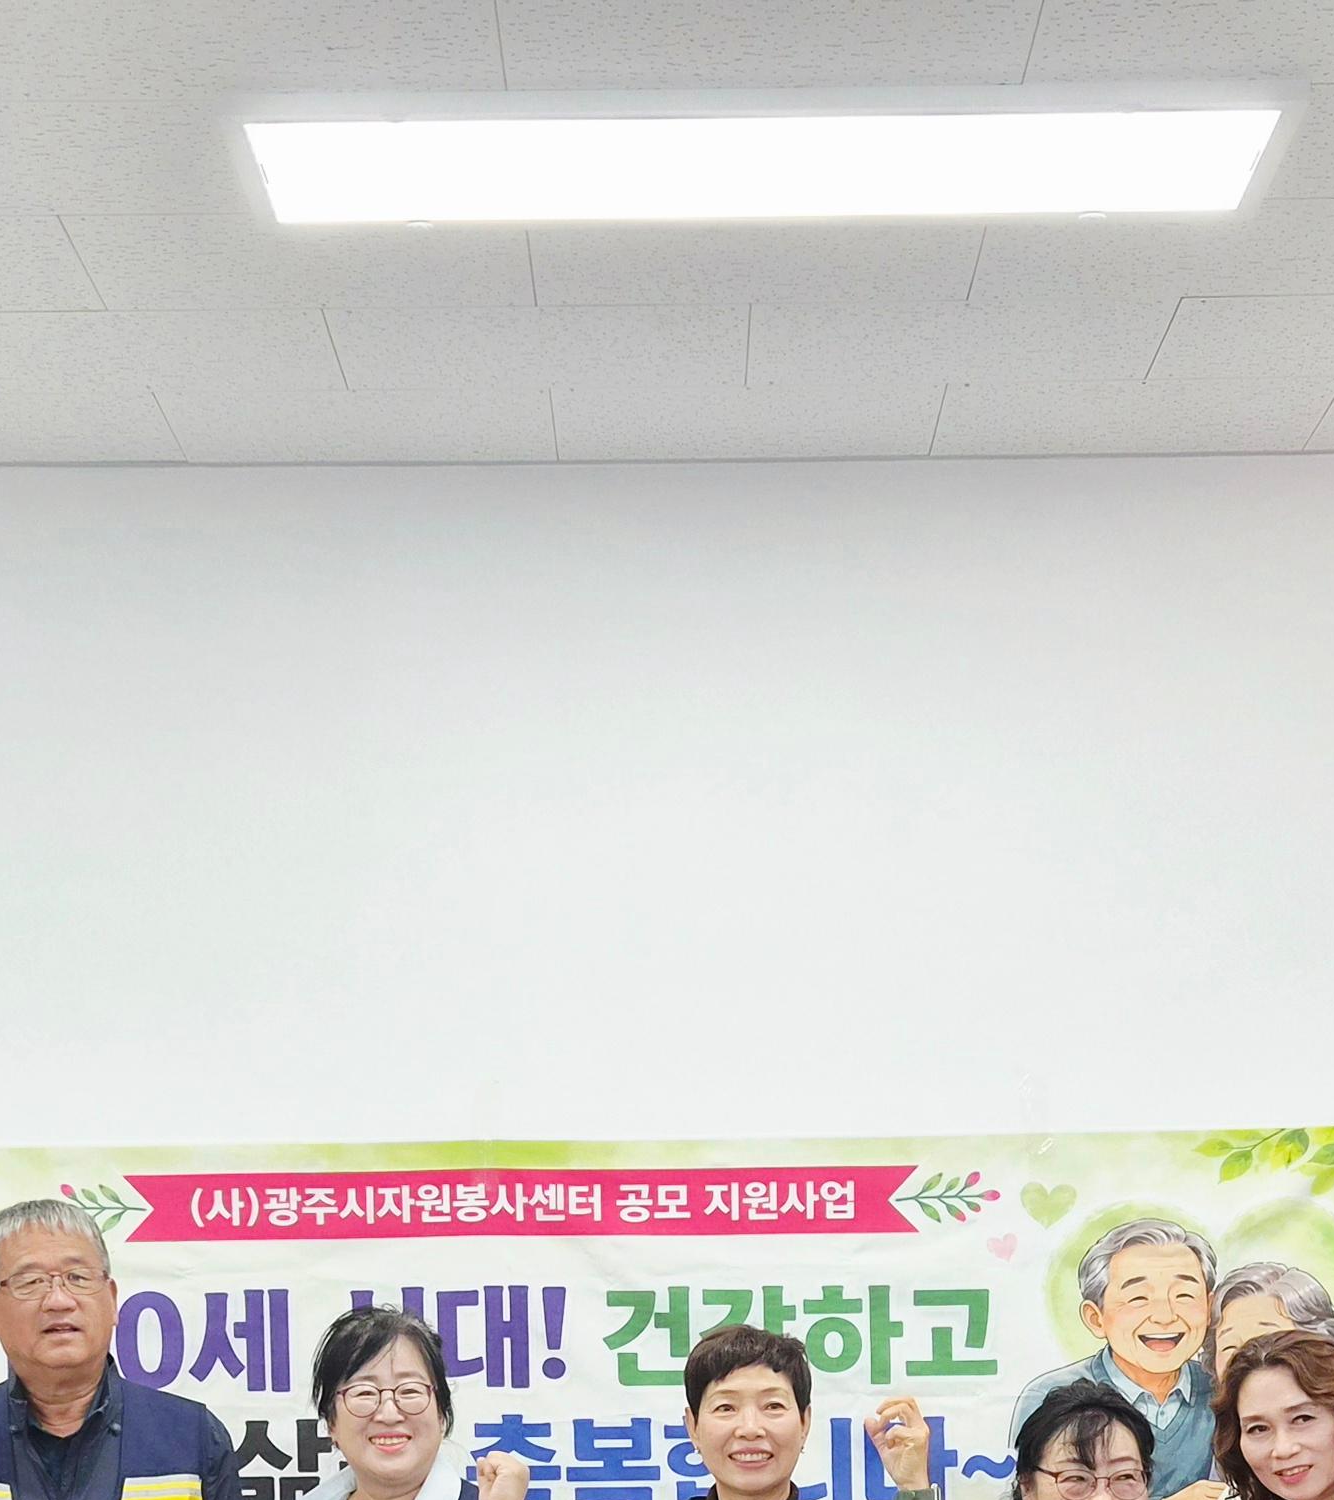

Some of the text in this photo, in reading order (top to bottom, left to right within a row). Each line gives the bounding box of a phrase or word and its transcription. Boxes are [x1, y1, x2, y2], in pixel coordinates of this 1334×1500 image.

[190, 1180, 856, 1228] (사)광주시자원봉사센터 공모 지원사업
[350, 1285, 566, 1389] 대!
